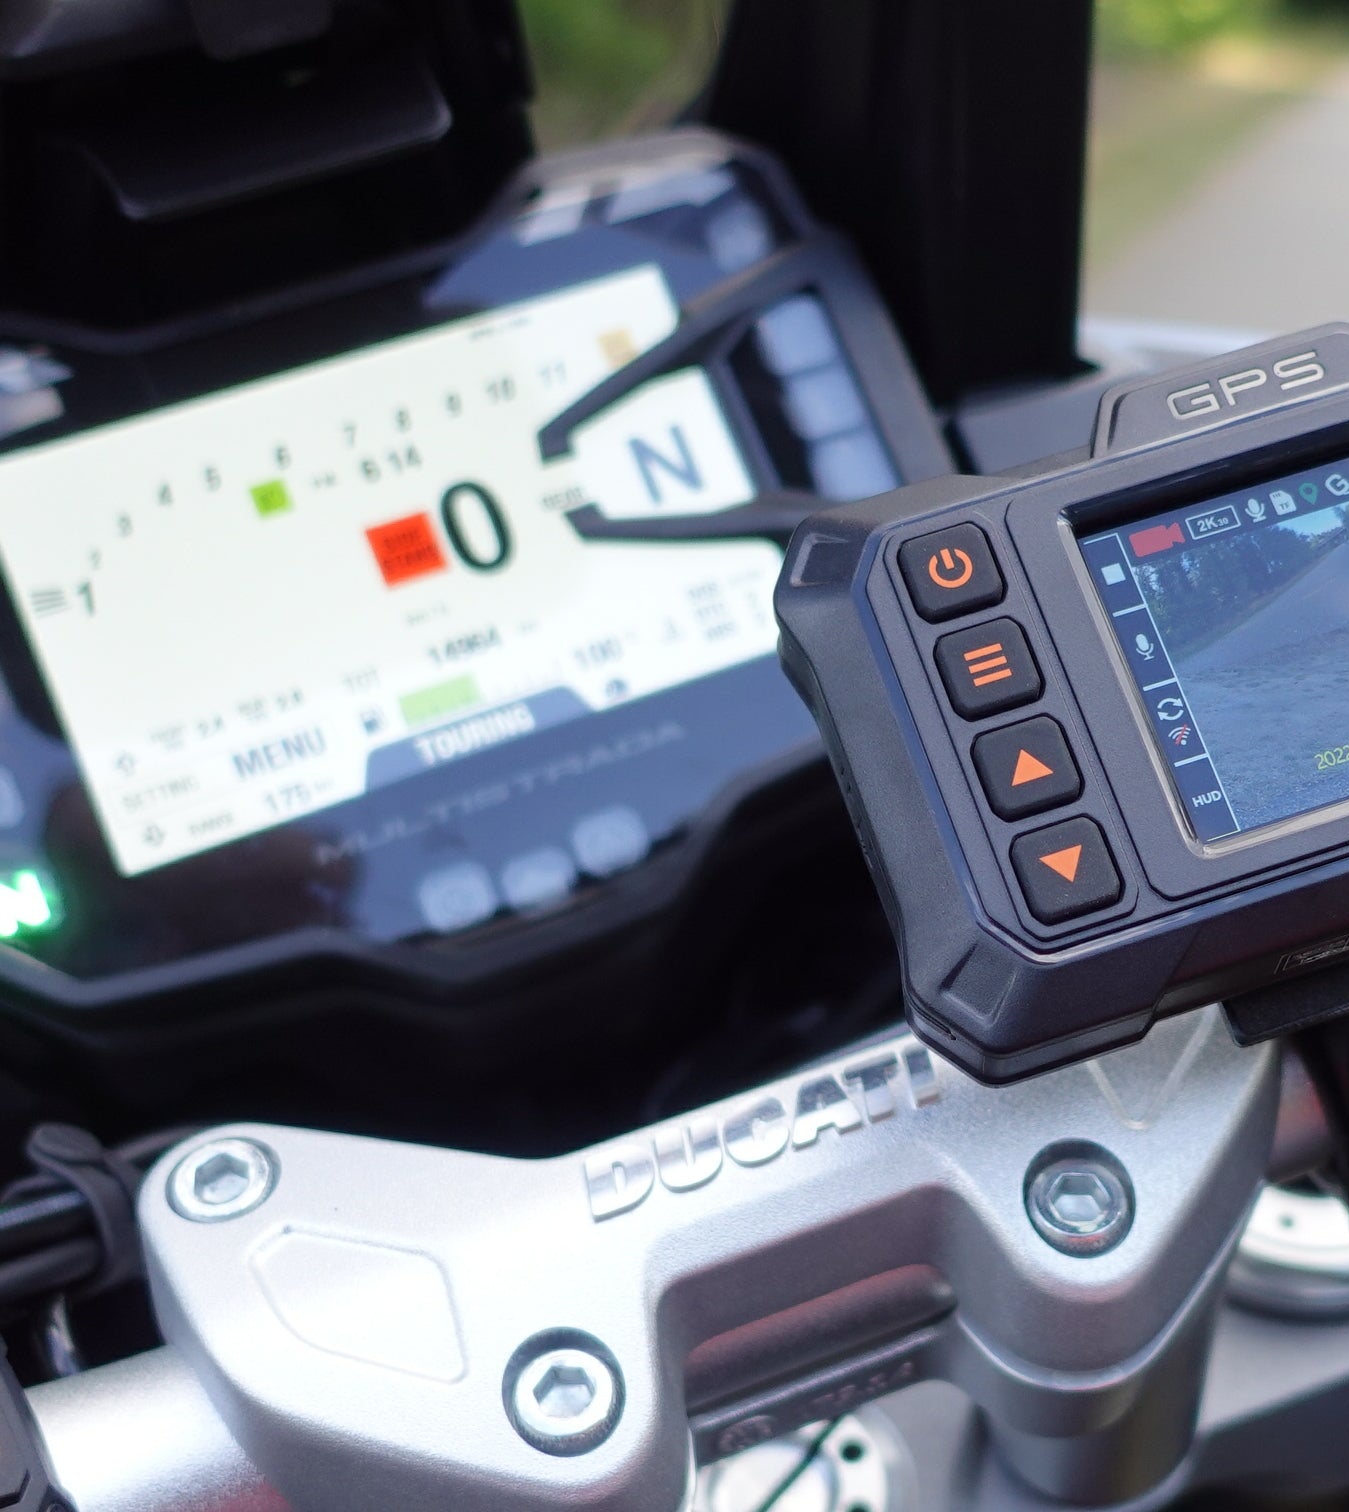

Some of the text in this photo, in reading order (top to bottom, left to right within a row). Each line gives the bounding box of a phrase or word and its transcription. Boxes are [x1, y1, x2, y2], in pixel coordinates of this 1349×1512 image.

[1167, 351, 1324, 420] GPS
[628, 424, 704, 506] N
[440, 481, 515, 574] 0
[77, 580, 96, 616] 1
[231, 727, 327, 781] MENU
[414, 702, 535, 768] TOURING
[1192, 791, 1221, 807] HUD
[584, 1047, 939, 1223] DUCATI
